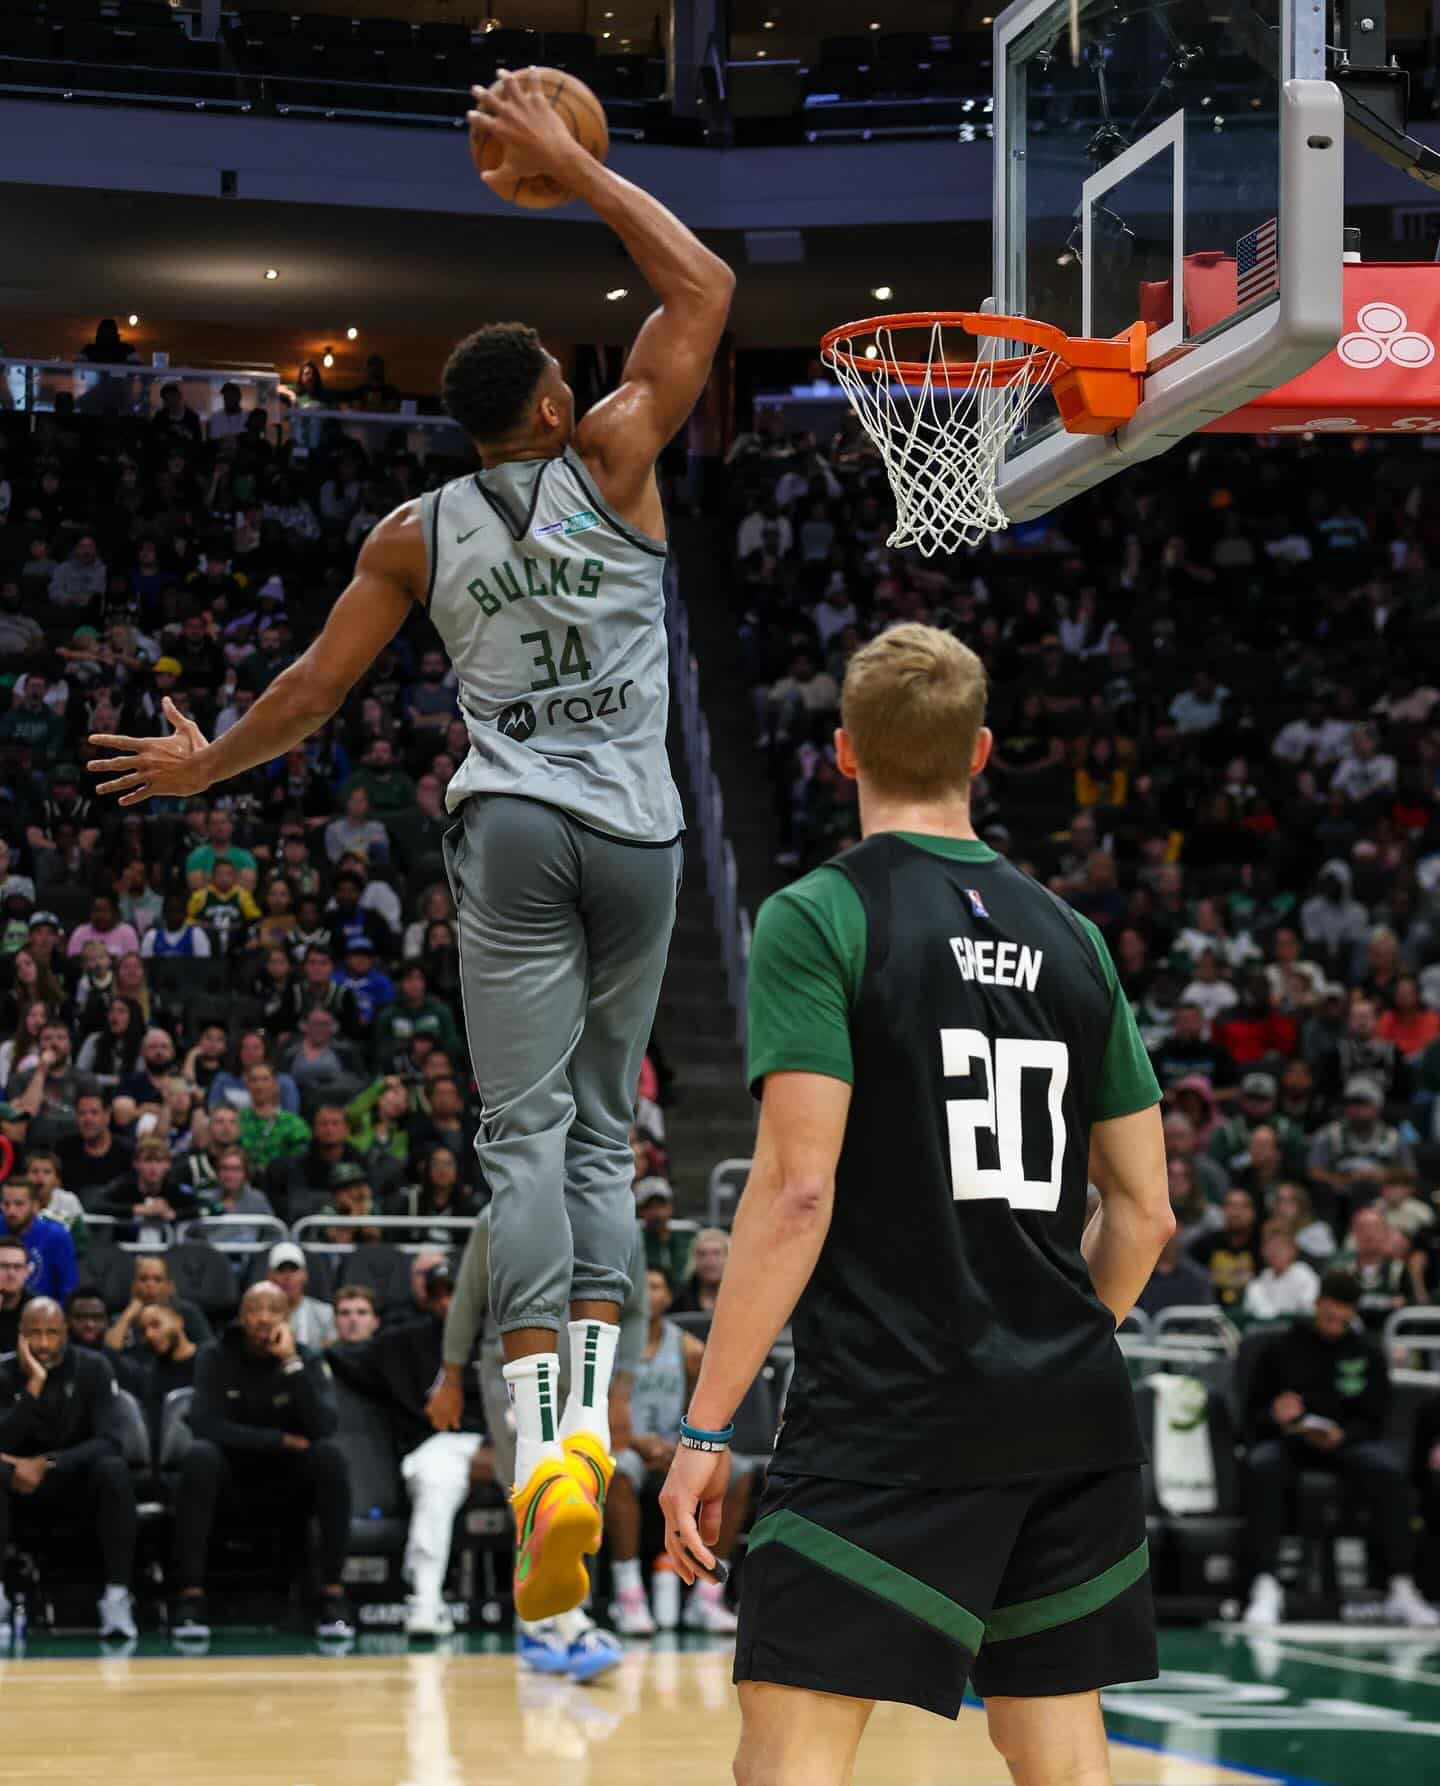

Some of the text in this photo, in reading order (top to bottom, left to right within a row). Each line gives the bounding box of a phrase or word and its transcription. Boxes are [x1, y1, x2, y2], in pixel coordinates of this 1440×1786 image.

[467, 557, 604, 617] BUCKS
[520, 626, 592, 691] 34
[547, 679, 634, 725] razr
[949, 937, 1043, 992] GREEN
[940, 1028, 1069, 1212] 20
